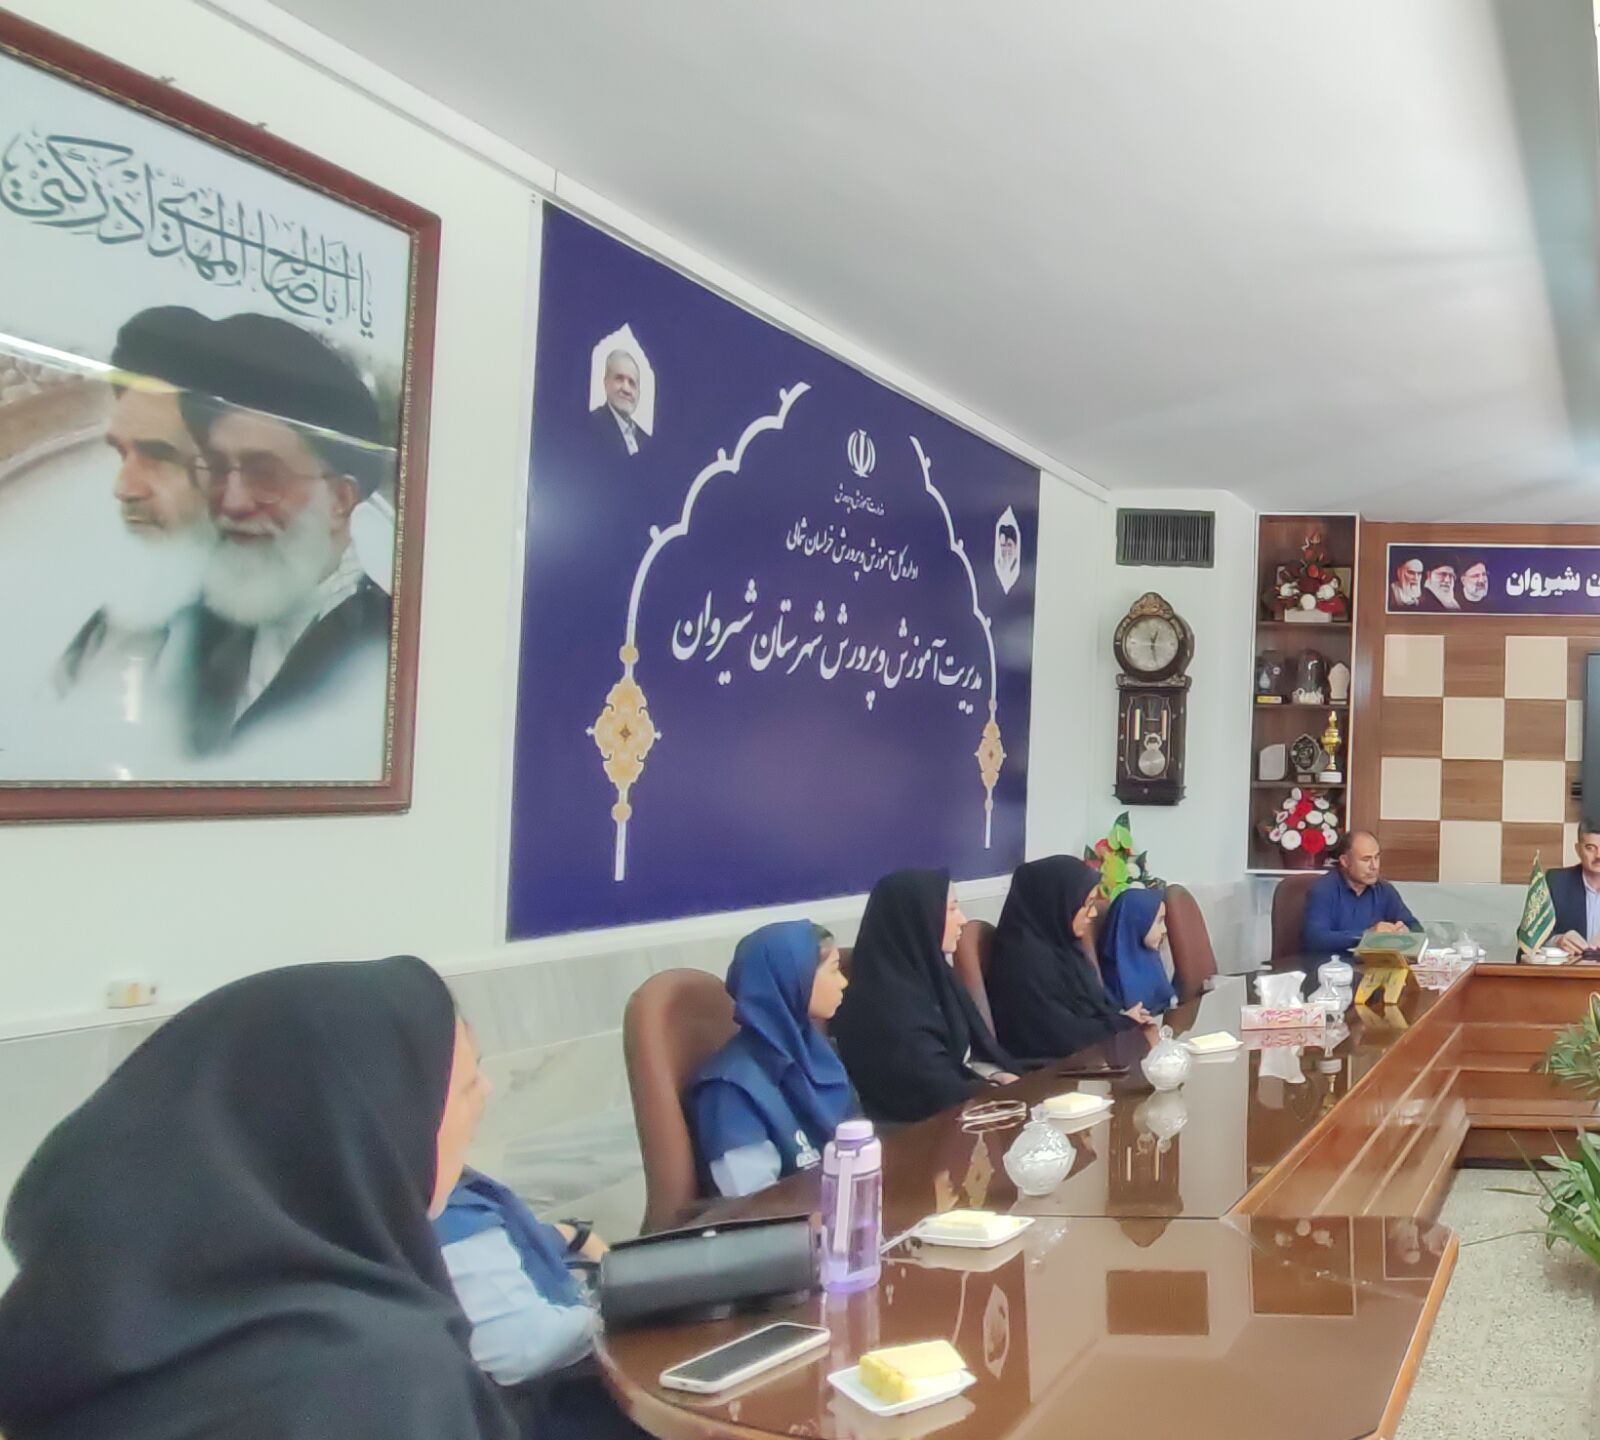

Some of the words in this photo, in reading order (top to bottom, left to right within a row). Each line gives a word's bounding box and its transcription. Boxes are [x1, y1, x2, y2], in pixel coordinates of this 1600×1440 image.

[786, 516, 808, 551] شمالی
[804, 524, 834, 556] خراسان
[832, 526, 861, 581] پرورش
[863, 537, 896, 573] آموزش
[890, 544, 909, 581] کل
[902, 560, 919, 580] اداره
[1505, 566, 1581, 597] شیروان
[671, 577, 758, 686] شیروان
[750, 598, 825, 675] شهرستان
[820, 601, 879, 711] پرورش
[874, 649, 886, 674] و
[883, 616, 947, 689] آموزش
[938, 654, 983, 715] مدیریت
